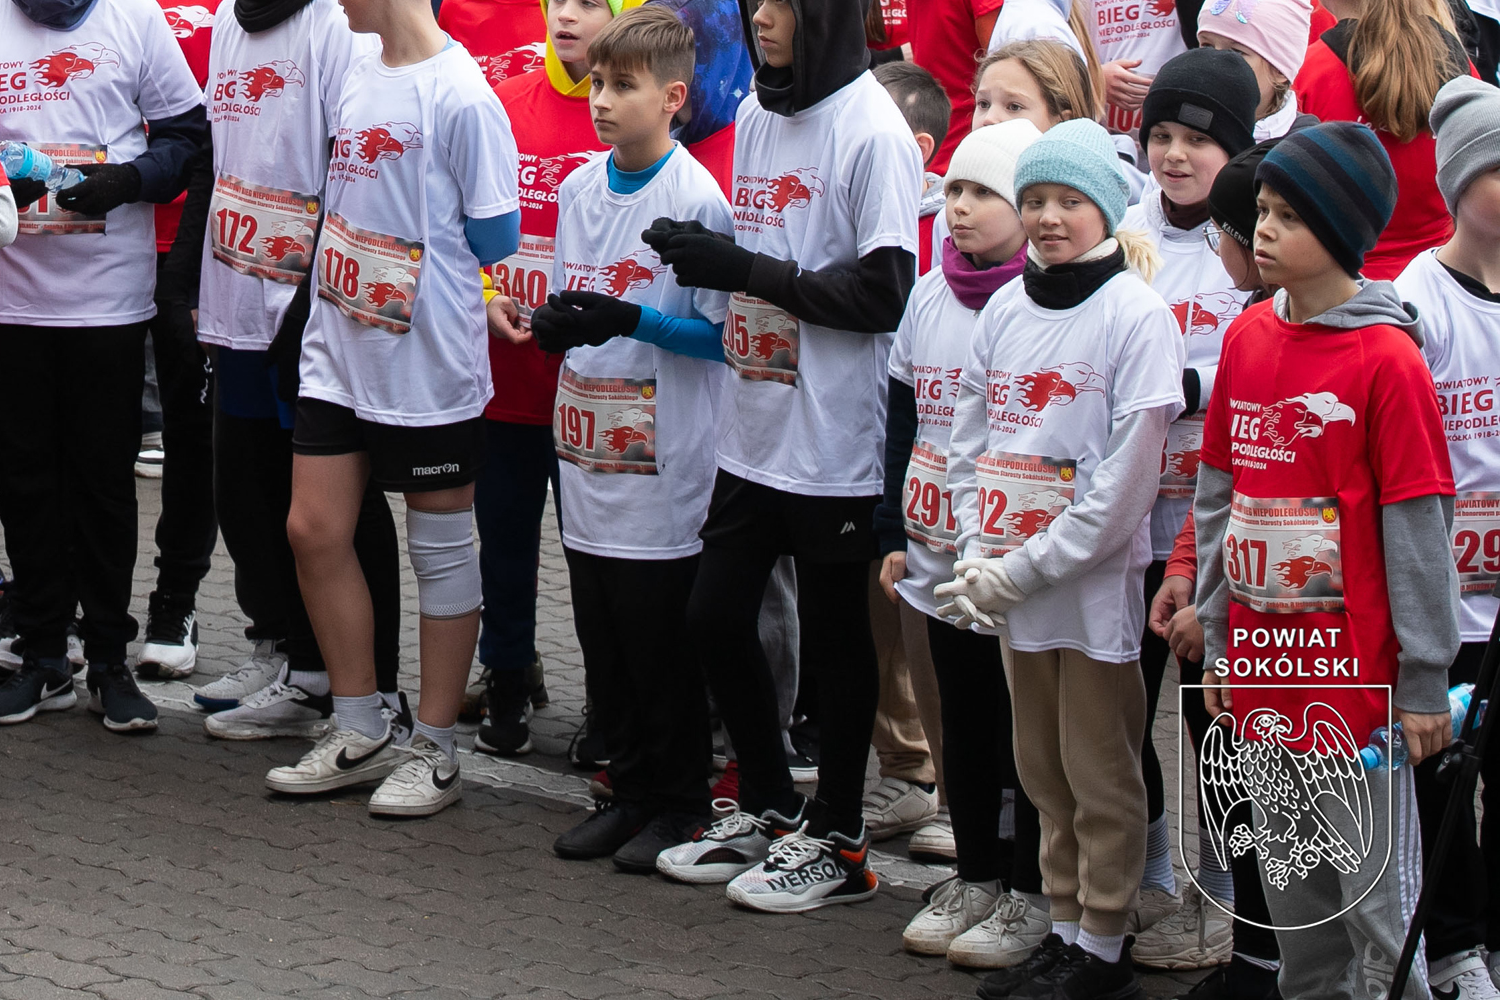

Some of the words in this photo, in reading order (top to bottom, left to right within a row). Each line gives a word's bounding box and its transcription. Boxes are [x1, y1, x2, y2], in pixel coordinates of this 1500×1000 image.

[1098, 5, 1140, 26] BIEG
[9, 104, 42, 113] 1918-2024
[217, 208, 258, 255] 172
[1222, 222, 1249, 246] KALENJI
[522, 241, 535, 251] BIEG
[324, 247, 360, 299] 178
[494, 263, 548, 309] 340
[916, 378, 943, 400] IEG
[1435, 376, 1489, 390] OWIATOWY
[1230, 398, 1261, 413] WIATOWY
[1439, 389, 1494, 417] BIEG
[558, 402, 596, 451] 197
[1231, 415, 1261, 440] IEG
[1232, 442, 1296, 464] PODLEGŁOŚCI
[413, 463, 459, 476] macron
[999, 471, 1021, 480] Starosty
[1022, 472, 1056, 482] Sokólskiego
[907, 477, 956, 531] 291
[1455, 499, 1500, 509] OWIATOWY
[1226, 534, 1267, 587] 317
[1454, 529, 1500, 574] 29
